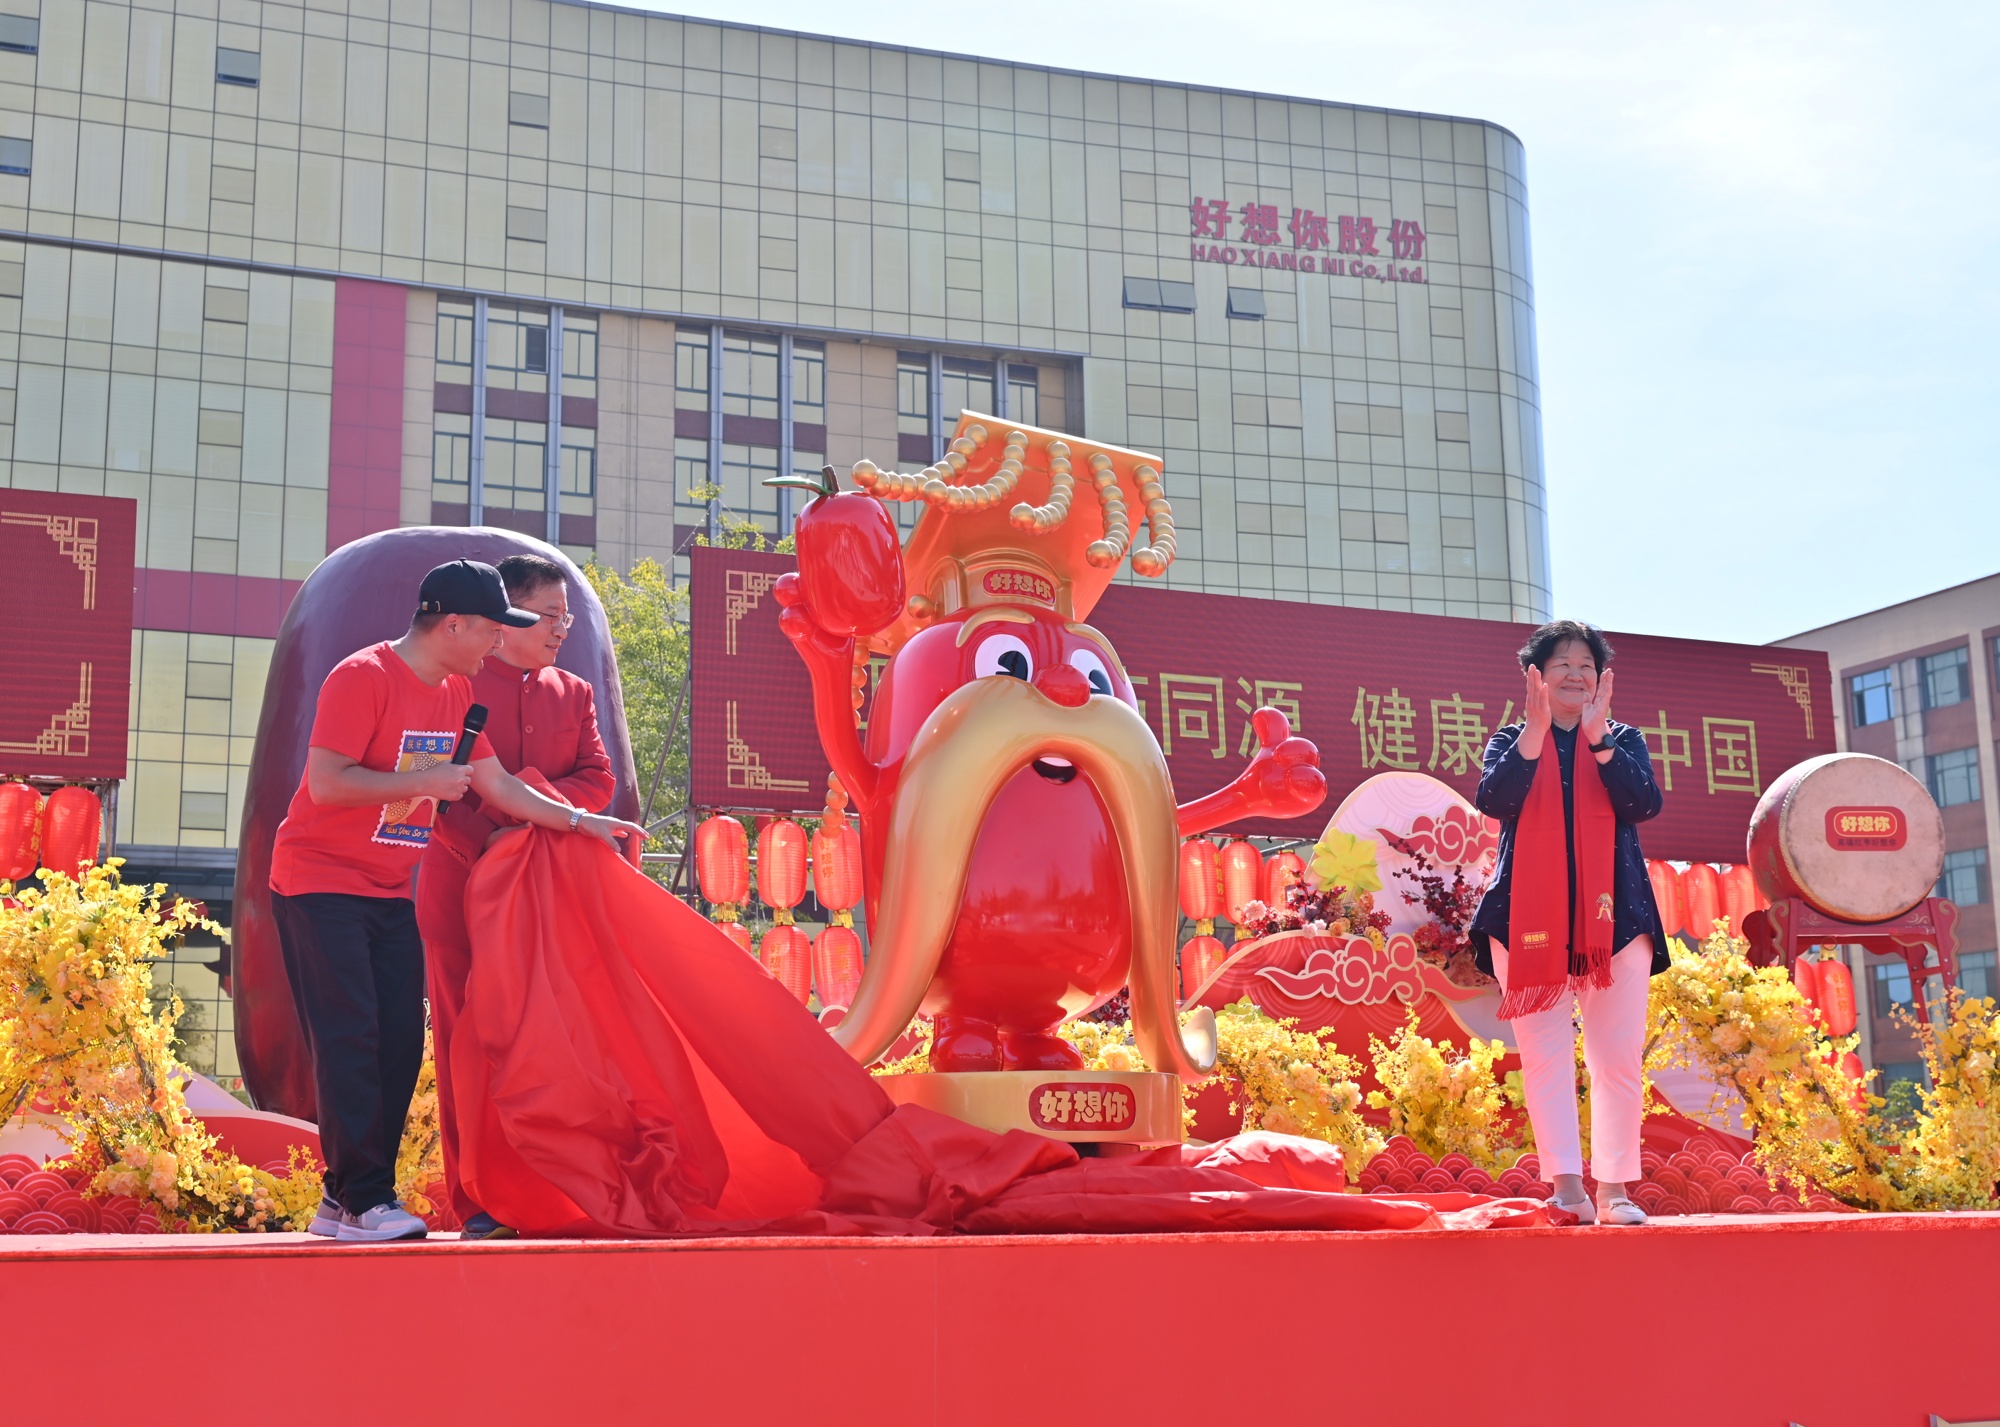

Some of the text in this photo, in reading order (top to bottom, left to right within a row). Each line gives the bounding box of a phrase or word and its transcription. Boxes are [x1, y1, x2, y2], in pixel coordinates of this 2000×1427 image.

[1190, 196, 1426, 261] 好想你股份
[1191, 243, 1237, 265] HAO
[1242, 247, 1315, 273] XIANG
[1322, 256, 1346, 276] NI
[990, 573, 1052, 598] 好想你
[1351, 686, 1761, 797] 健康中国
[383, 825, 398, 834] Miss
[397, 826, 411, 837] You
[412, 828, 422, 837] So
[1841, 816, 1890, 832] 好想你
[1040, 1090, 1129, 1123] 好想你
